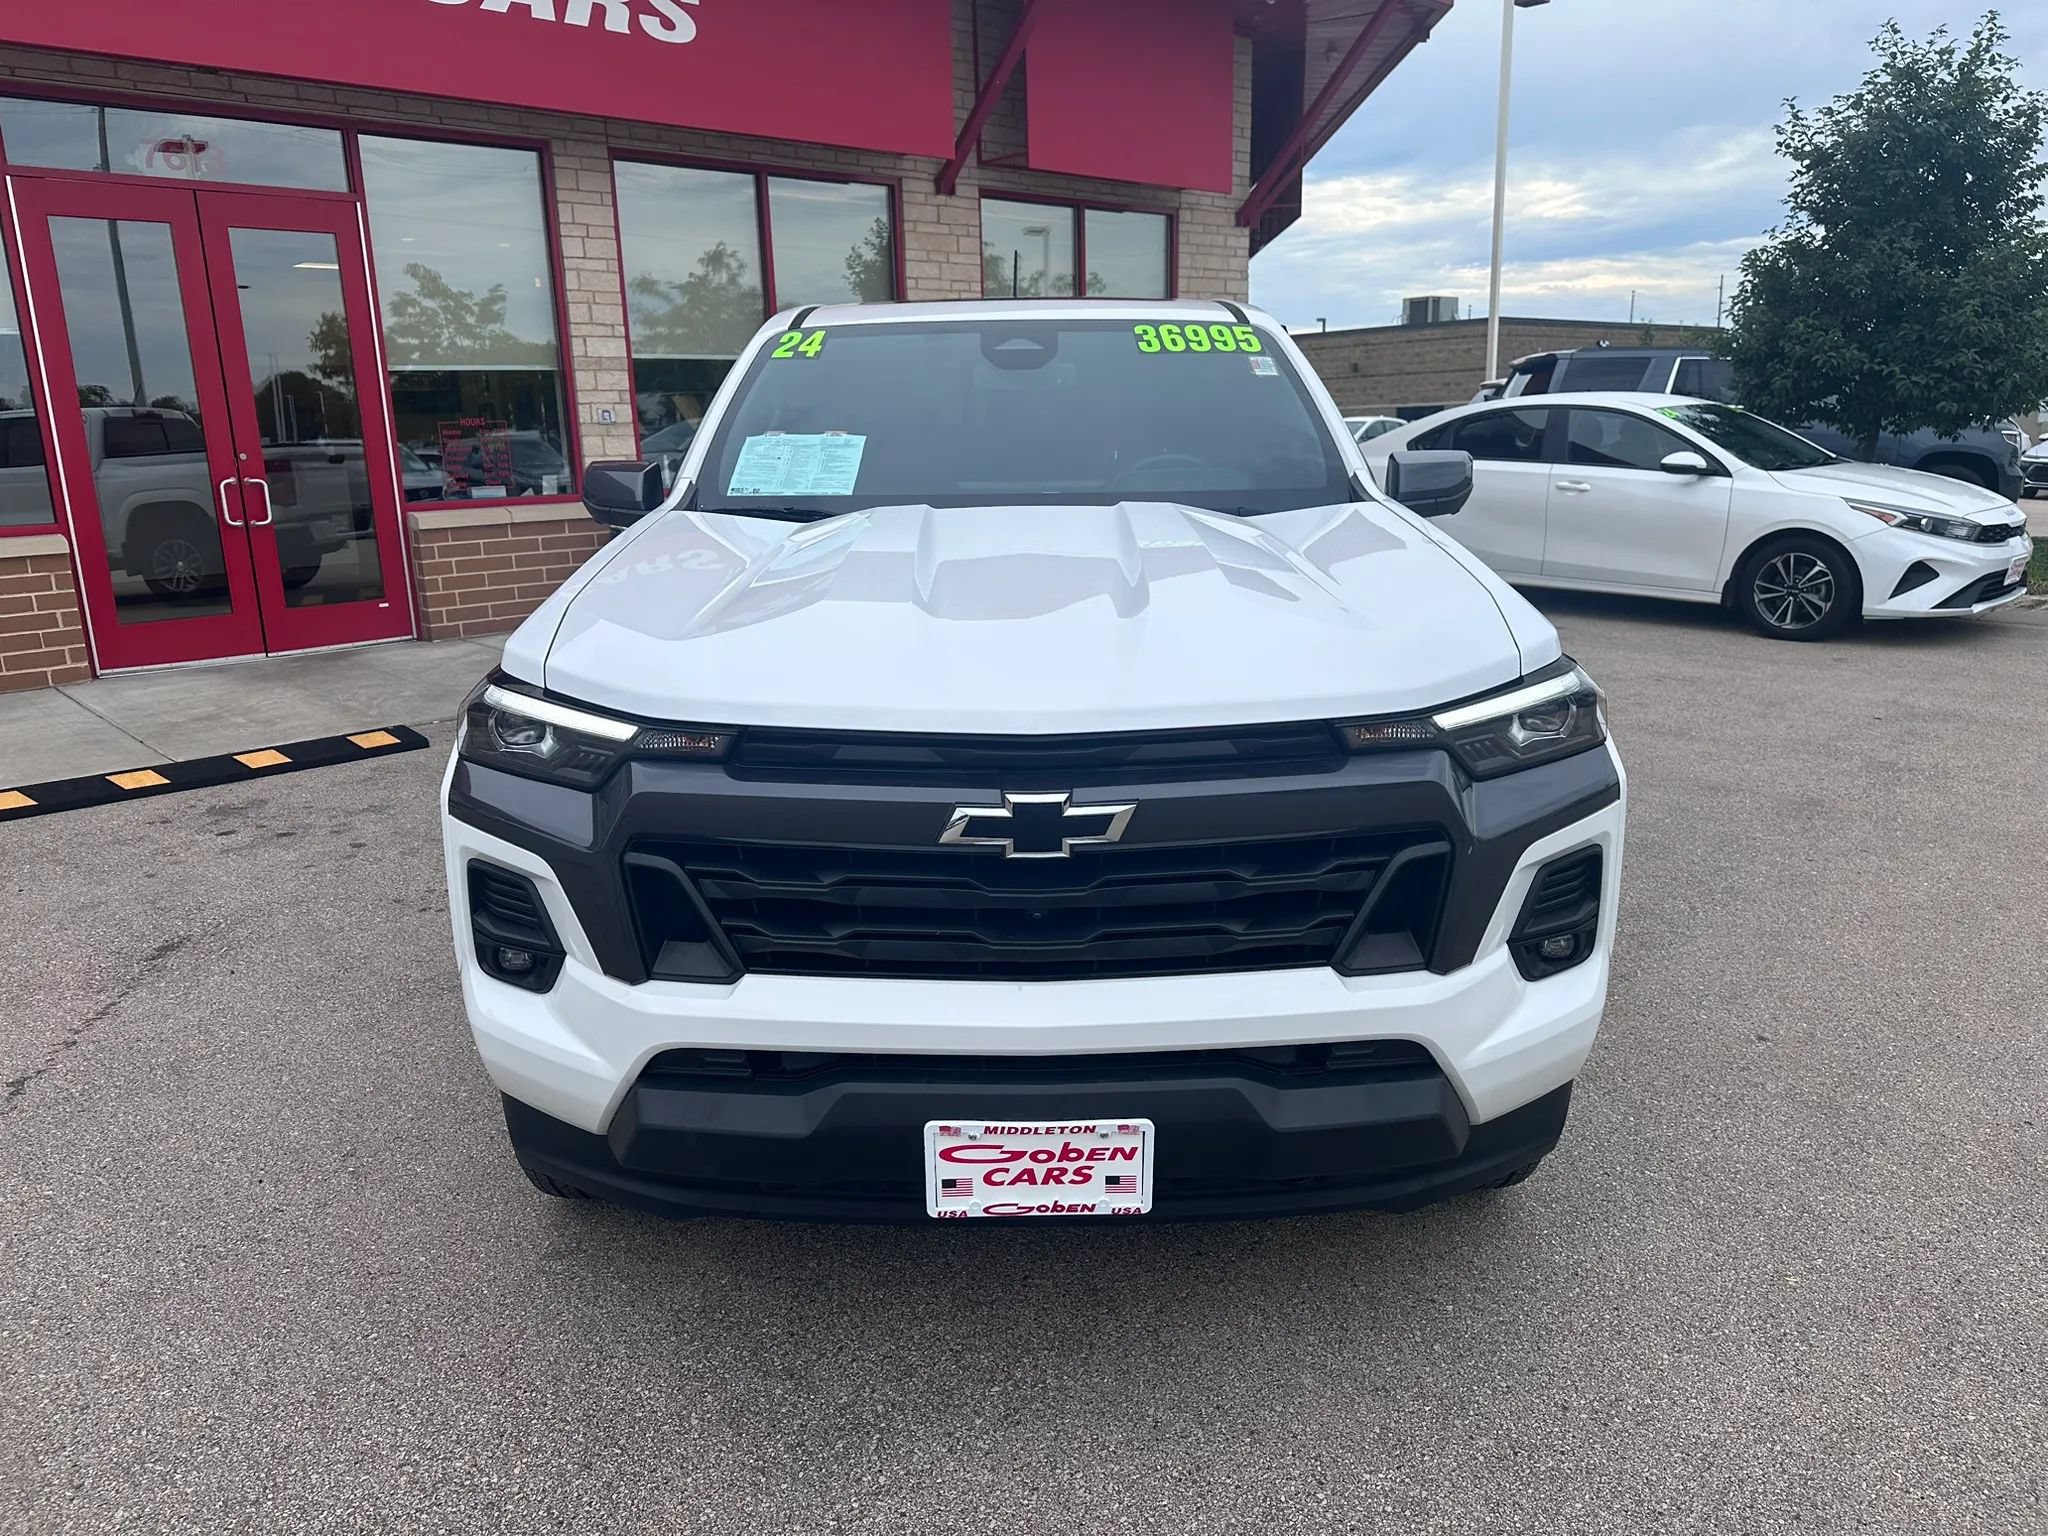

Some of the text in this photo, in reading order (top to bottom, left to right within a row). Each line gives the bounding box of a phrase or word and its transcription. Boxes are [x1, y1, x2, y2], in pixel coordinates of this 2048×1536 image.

[1133, 324, 1262, 353] 36995
[771, 330, 826, 358] 24
[460, 417, 486, 427] HOURS
[983, 1125, 1097, 1135] MIDDLETON
[982, 1165, 1095, 1187] CARS
[937, 1210, 968, 1218] USA
[1111, 1207, 1142, 1216] USA
